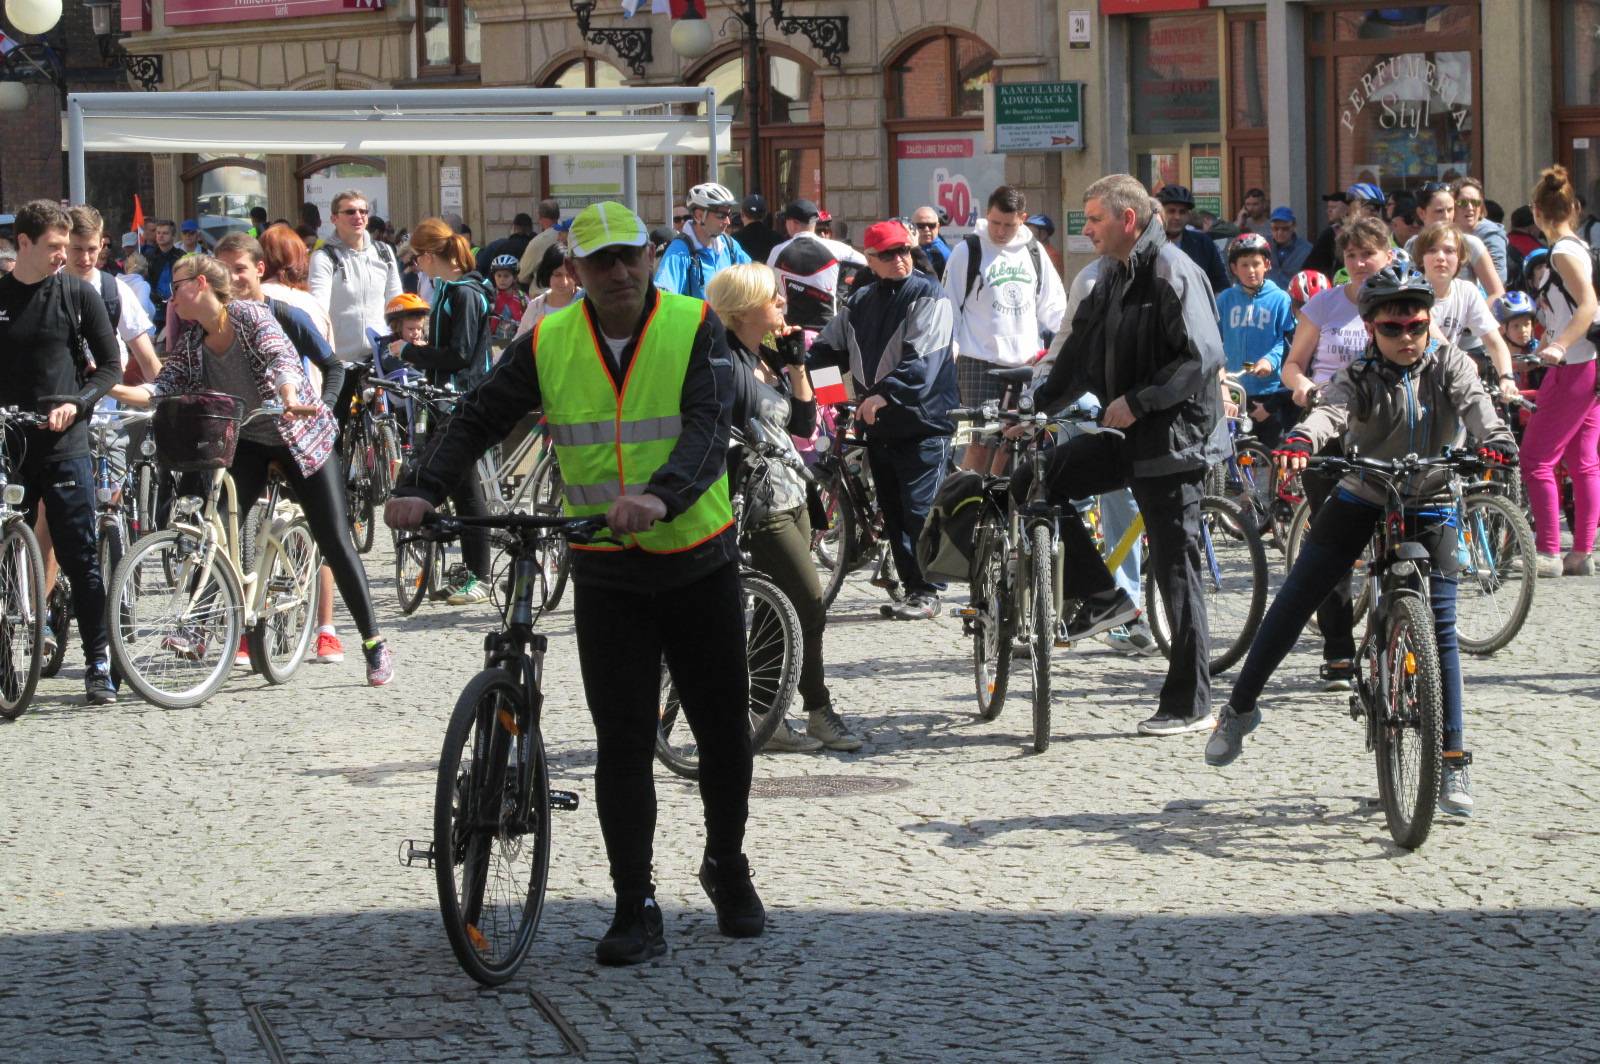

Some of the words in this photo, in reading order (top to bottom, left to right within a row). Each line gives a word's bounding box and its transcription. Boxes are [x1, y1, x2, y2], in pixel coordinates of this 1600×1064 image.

[1074, 17, 1085, 33] 20
[1001, 84, 1072, 95] KANCELARIA
[1001, 95, 1072, 105] ADWOKACKA
[1341, 55, 1467, 134] PERFUMERIA
[1380, 93, 1430, 139] Styl
[938, 182, 970, 227] 50
[1230, 304, 1271, 329] GAP
